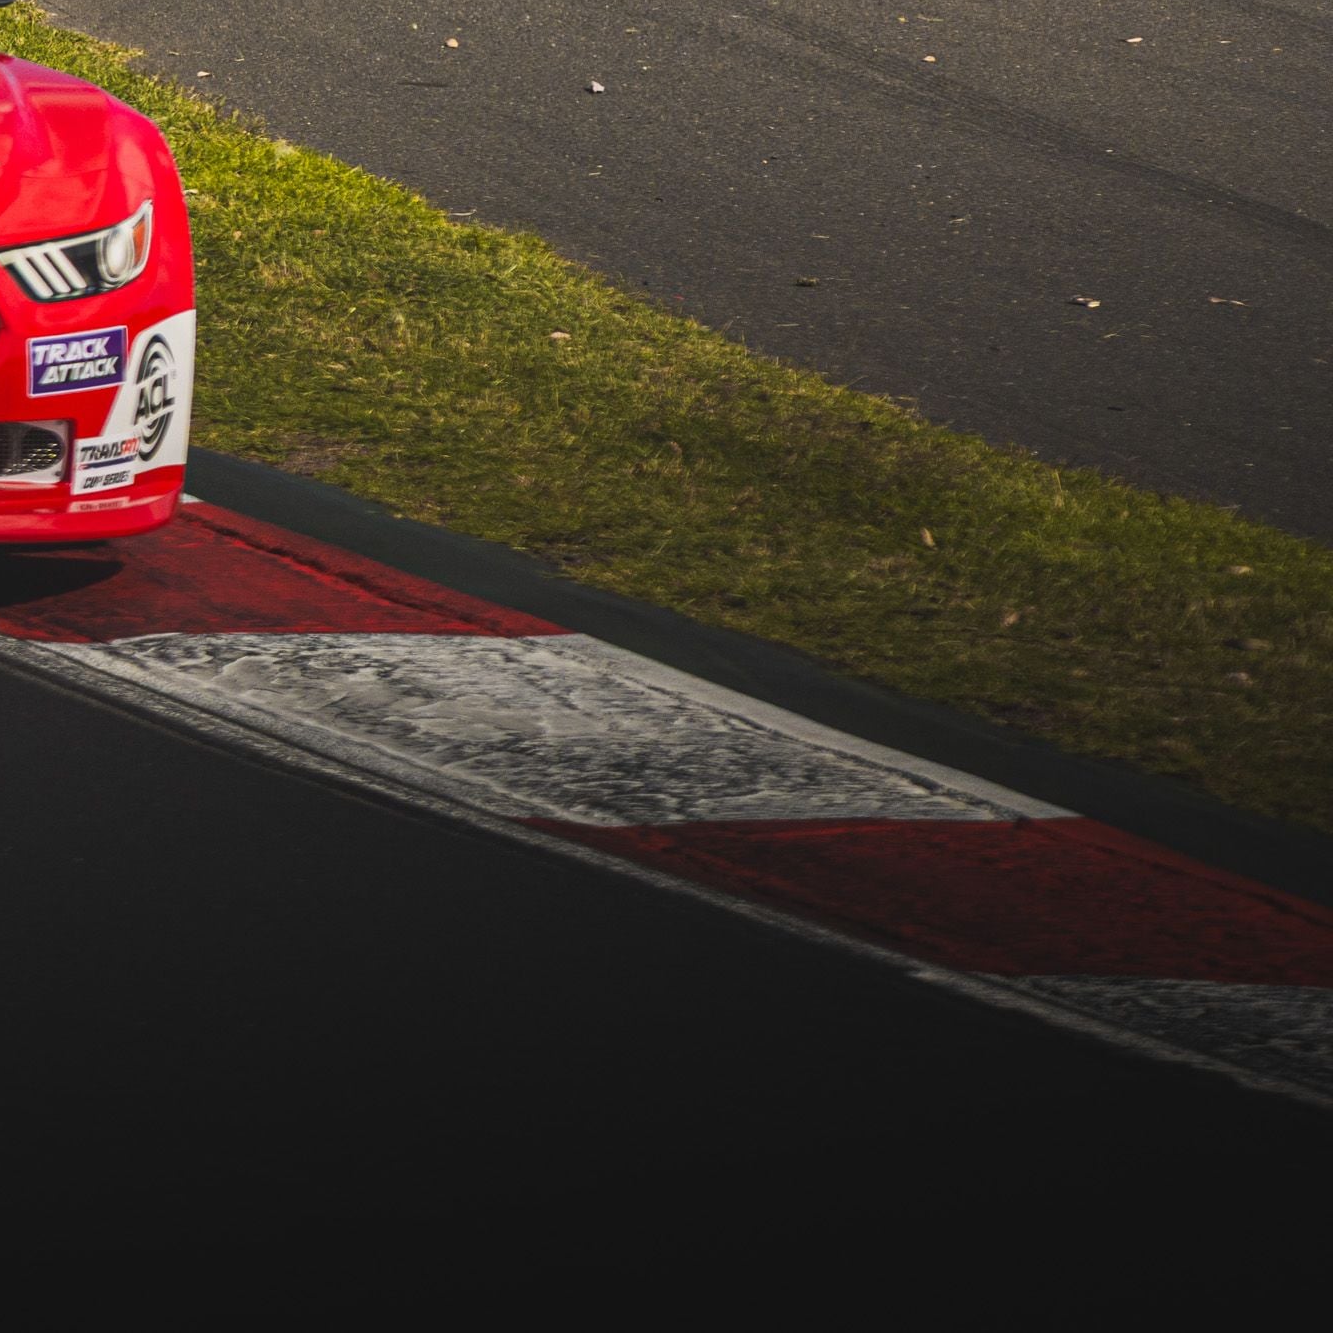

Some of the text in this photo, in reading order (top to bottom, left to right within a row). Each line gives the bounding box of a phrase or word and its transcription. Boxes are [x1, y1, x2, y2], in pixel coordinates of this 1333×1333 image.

[33, 337, 111, 366] TRACK
[39, 356, 120, 385] ATTACK
[134, 371, 175, 426] ACL
